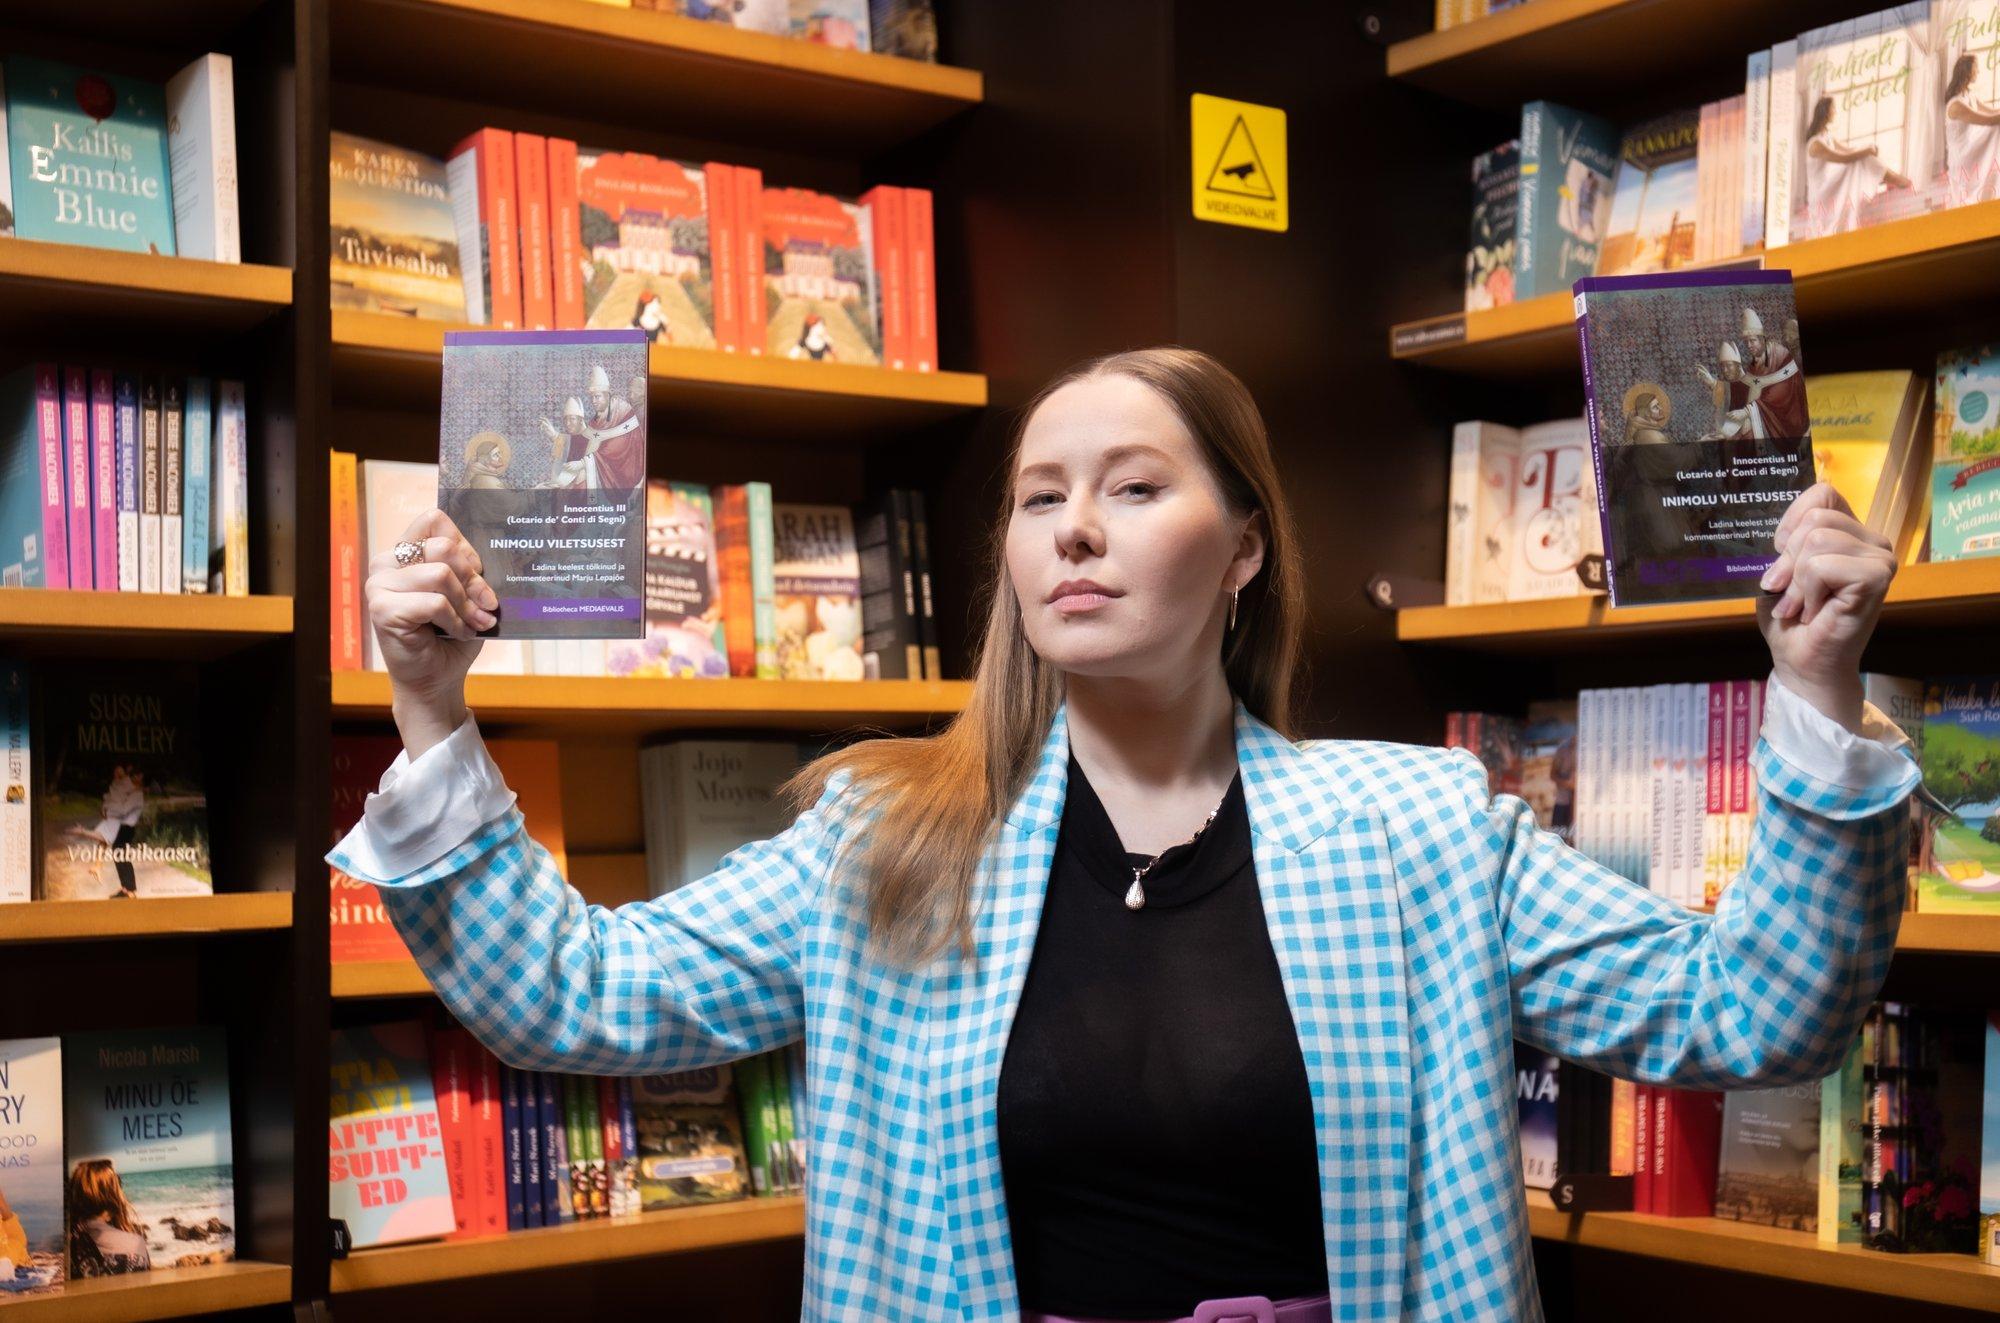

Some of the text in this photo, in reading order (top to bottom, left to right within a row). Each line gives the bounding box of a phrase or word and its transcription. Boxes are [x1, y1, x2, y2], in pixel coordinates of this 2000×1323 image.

[53, 122, 133, 162] Kallis
[28, 145, 160, 199] Emmie
[354, 149, 419, 176] KAREN
[330, 161, 446, 201] McQUESTION
[53, 187, 138, 234] Blue
[1207, 201, 1276, 220] VIDEOVALVE
[340, 236, 449, 279] Tuvisaba
[1580, 327, 1591, 376] Innocentius
[1588, 398, 1599, 444] INIMOLU
[46, 442, 59, 506] MACOMBER
[1676, 466, 1799, 481] (Lotario de' Conti di Segni)
[1733, 454, 1798, 465] Innocentius III
[74, 444, 86, 509] MACOMBER
[99, 445, 111, 510] MACOMBER
[122, 447, 135, 511] MACOMBER
[145, 450, 157, 514] MACOMBER
[167, 452, 179, 515] MACOMBER
[1592, 446, 1605, 512] VILETSUSEST
[563, 504, 626, 513] Innocentius III
[1662, 490, 1801, 507] INIMOLU VILETSUSEST
[1942, 492, 1985, 527] Aria
[507, 515, 626, 526] (Lotario de' Conti di Segni)
[1708, 517, 1782, 529] Ladina keelest tõlk
[490, 538, 626, 549] INIMOLU VILETSUSEST
[1684, 530, 1775, 542] kommenteerinud Marju
[506, 573, 625, 583] kommenteerinud Marju Lepajõe
[532, 562, 625, 572] Ladina keelest tõlkinud ja
[1726, 563, 1764, 573] Bibliotheca
[542, 605, 578, 613] Bibliotheca
[89, 693, 161, 722] SUSAN
[1891, 695, 1921, 719] SHE
[1959, 711, 2000, 723] Sue Ro
[78, 724, 176, 752] MALLERY
[692, 750, 743, 778] Jojo
[1711, 761, 1721, 809] ROBERTS
[1735, 760, 1745, 808] ROBERTS
[1672, 779, 1686, 870] rääkimata
[99, 1044, 200, 1069] Nicola Marsh
[105, 1075, 199, 1111] MINU ÕE
[122, 1111, 183, 1141] MEES
[358, 1177, 408, 1208] ED
[1560, 1183, 1575, 1205] S
